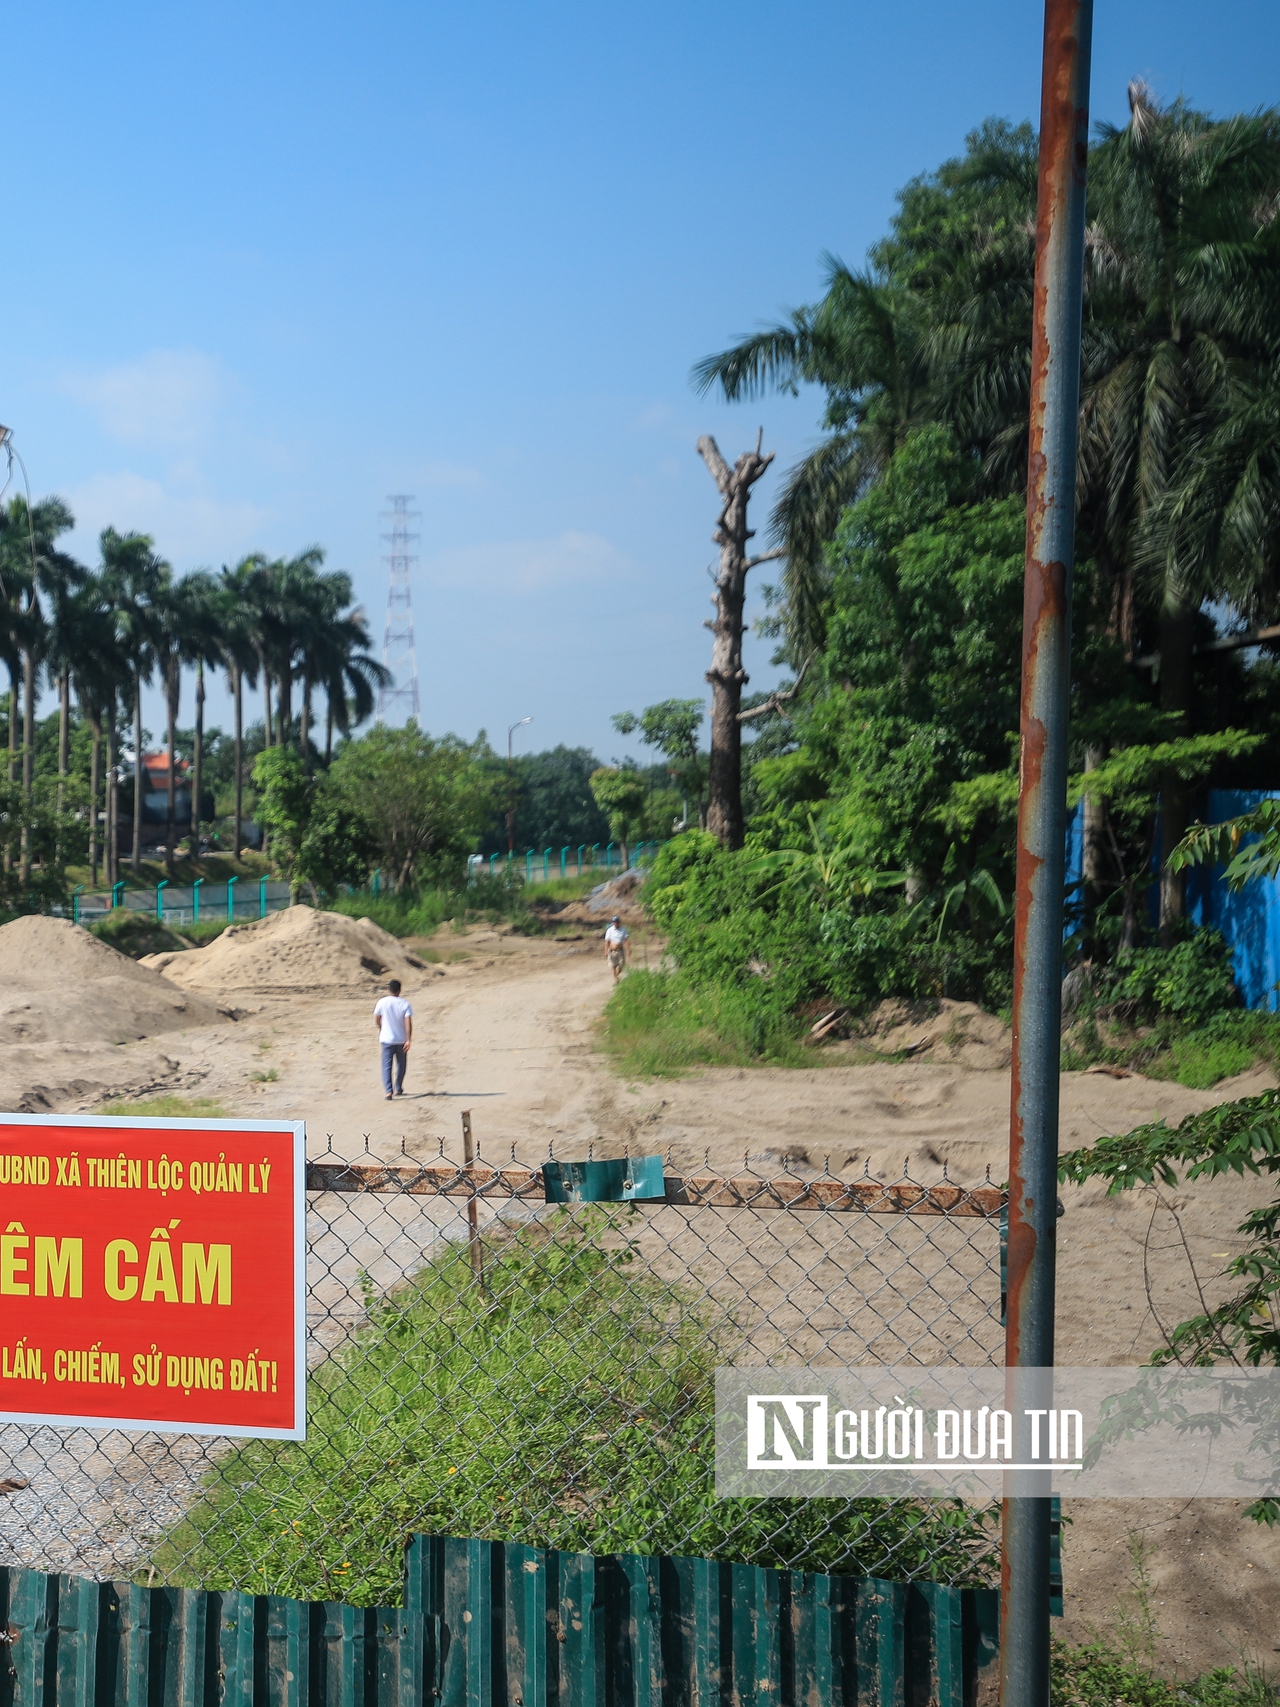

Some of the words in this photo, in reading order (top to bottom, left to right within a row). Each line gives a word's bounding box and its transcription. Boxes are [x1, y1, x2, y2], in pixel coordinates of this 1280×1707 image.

[55, 1151, 82, 1187] XÃ
[86, 1152, 142, 1189] THIÊN
[147, 1153, 184, 1197] LỘC
[189, 1152, 243, 1193] QUẢN
[248, 1157, 272, 1194] LÝ
[104, 1218, 232, 1306] CẤM
[2, 1336, 48, 1385] LẤN,
[53, 1341, 126, 1389] CHIẾM,
[132, 1343, 163, 1387] SỬ
[166, 1355, 224, 1396] DỤNG
[229, 1348, 278, 1393] ĐẤT!
